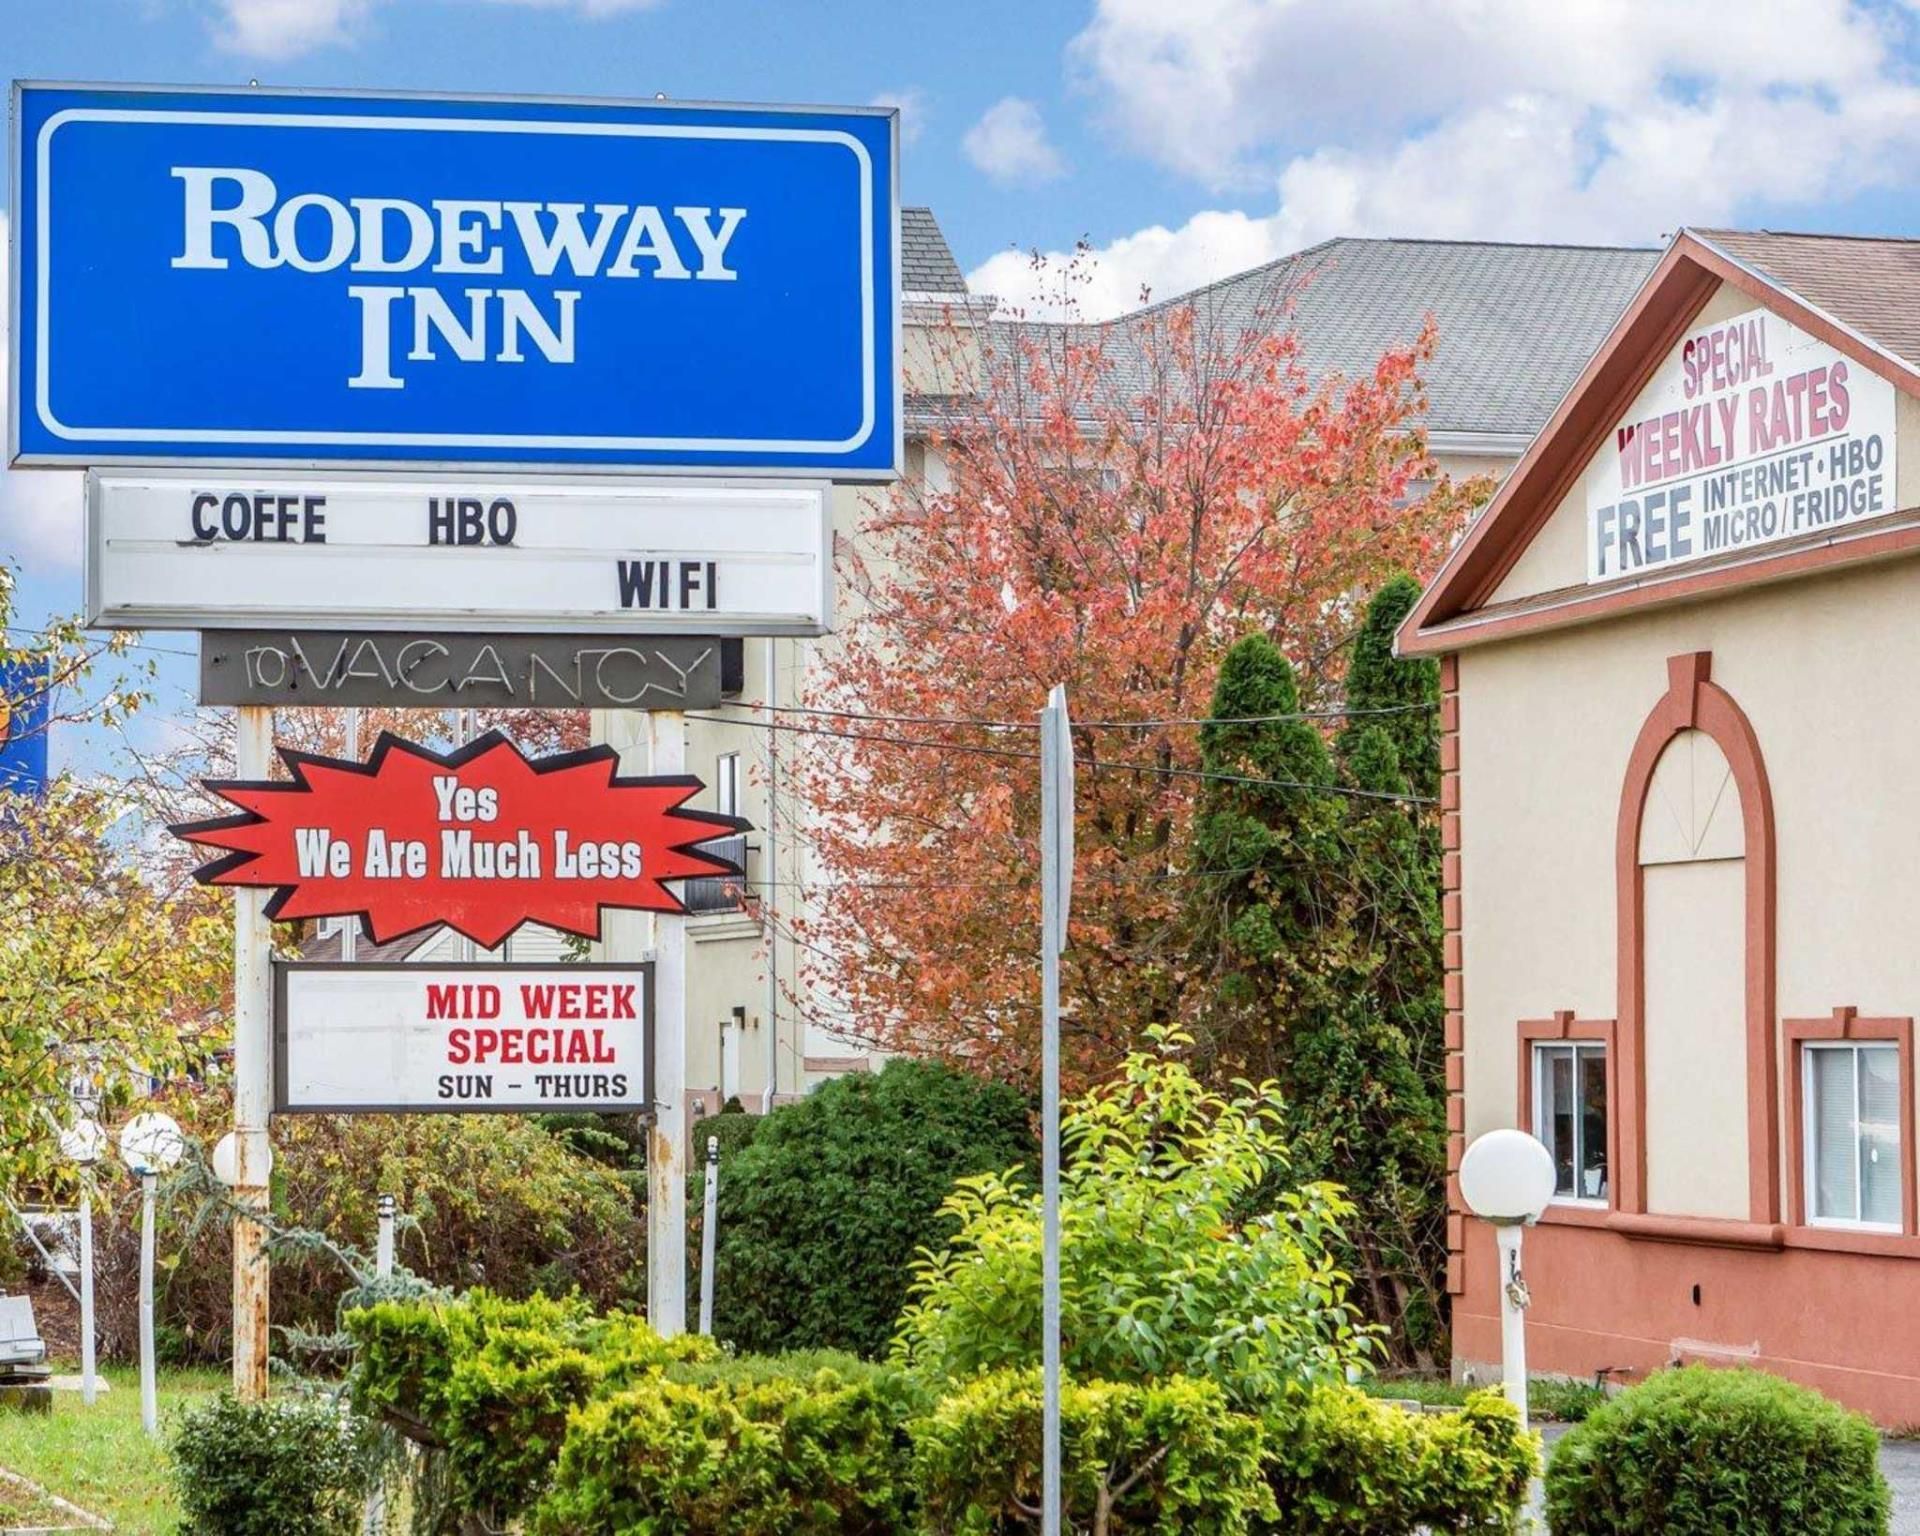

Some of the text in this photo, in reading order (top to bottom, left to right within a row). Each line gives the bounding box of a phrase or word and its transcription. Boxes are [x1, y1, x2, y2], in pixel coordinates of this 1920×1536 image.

[170, 166, 747, 281] RODEWAY
[347, 285, 582, 389] INN
[1682, 315, 1774, 401] SPECIAL
[1617, 360, 1851, 489] WEEKLY RATES
[191, 493, 517, 547] COFFE HBO
[1596, 485, 1693, 576] FREE
[291, 636, 712, 703] VACANCY
[432, 776, 499, 822] Yes
[295, 828, 643, 879] We Are Much Less
[425, 983, 637, 1019] MID WEEK
[447, 1028, 616, 1064] SPECIAL
[438, 1074, 493, 1098] SUN
[534, 1074, 628, 1098] THURS
